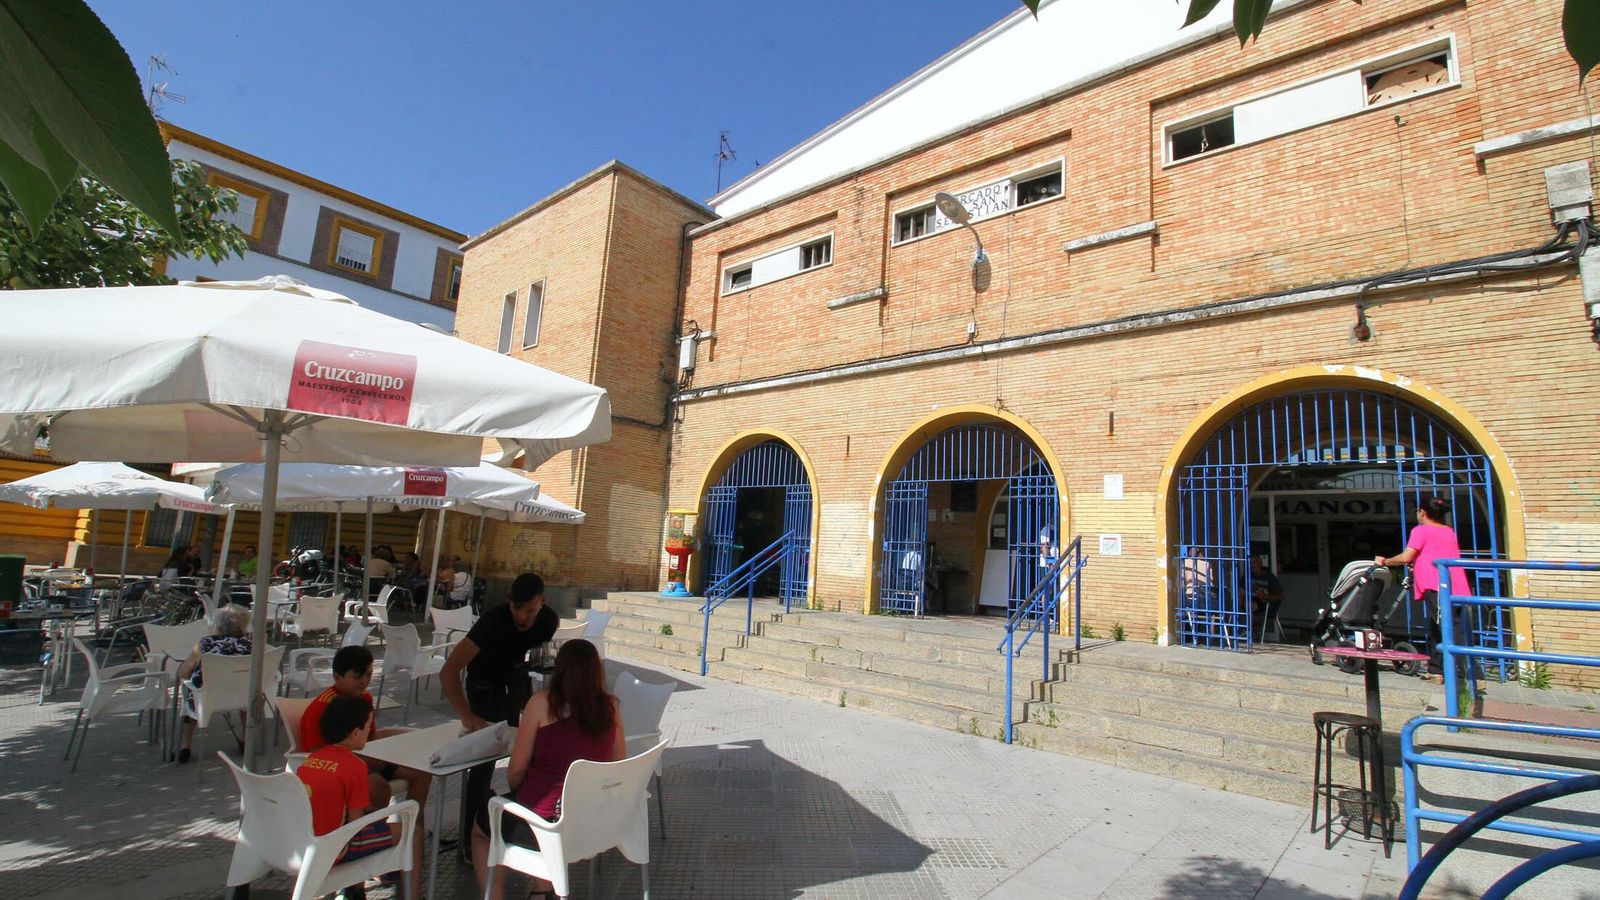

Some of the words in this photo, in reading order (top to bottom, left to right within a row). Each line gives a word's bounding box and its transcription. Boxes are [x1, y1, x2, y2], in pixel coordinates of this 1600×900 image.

[960, 184, 1002, 204] RCADO
[972, 194, 997, 210] SAN
[935, 199, 1009, 229] SESTIAN
[304, 360, 404, 391] Cruzcampo
[298, 380, 349, 394] MAESTROS
[350, 387, 406, 402] CERVECEROS
[408, 473, 444, 483] Cruzcampo
[173, 497, 216, 513] Cruzcampo
